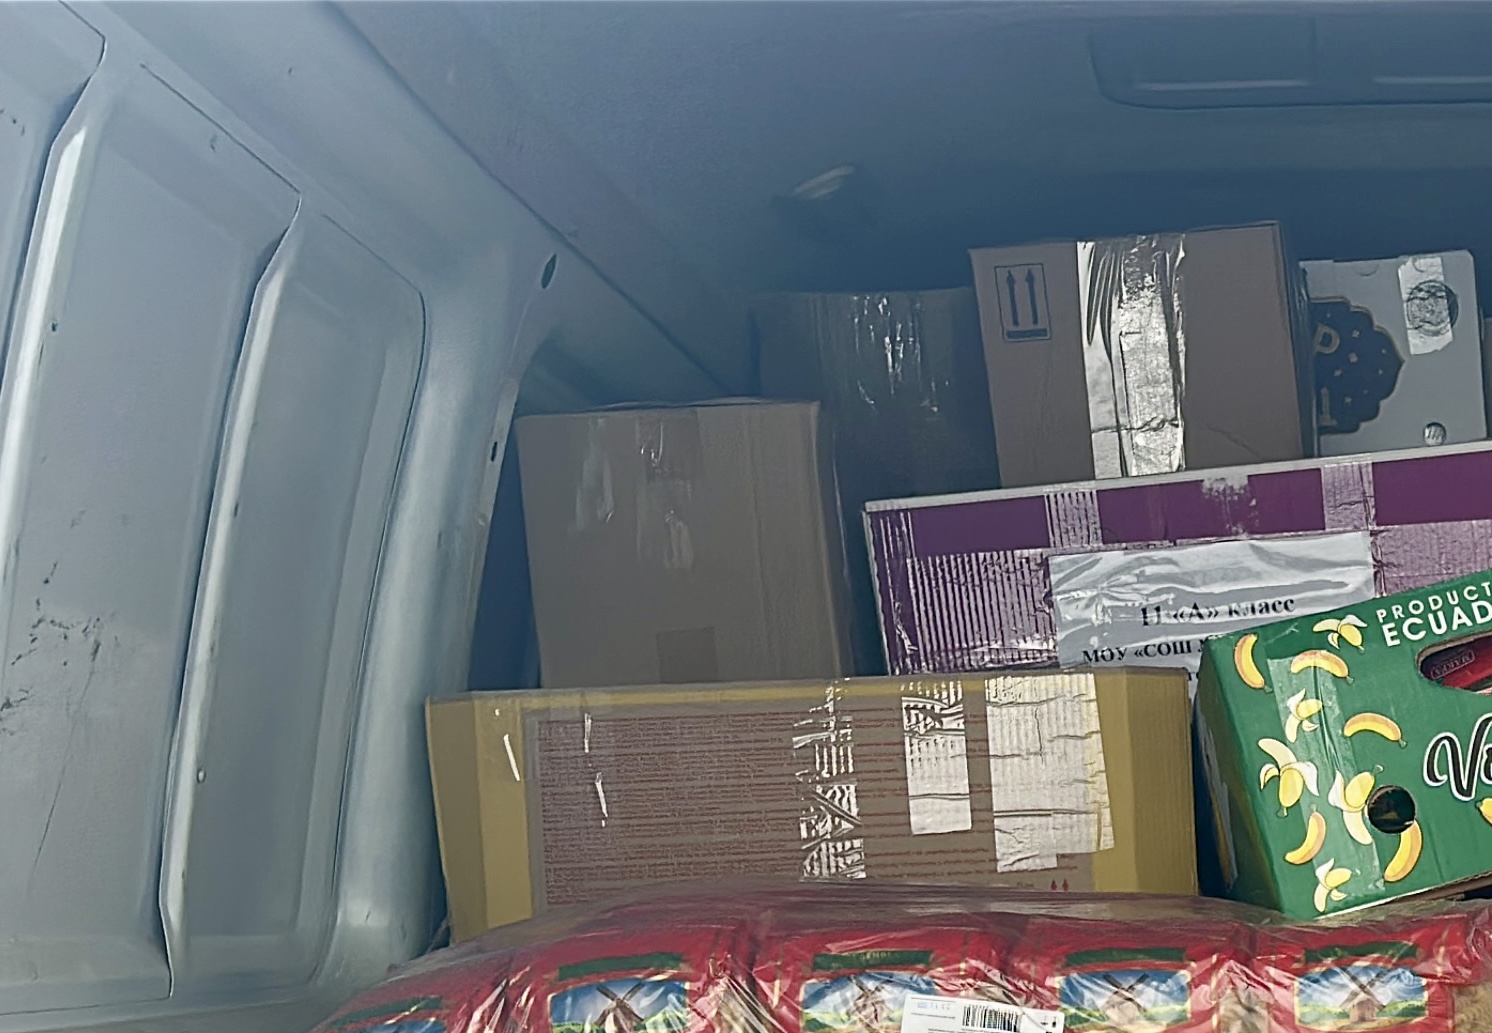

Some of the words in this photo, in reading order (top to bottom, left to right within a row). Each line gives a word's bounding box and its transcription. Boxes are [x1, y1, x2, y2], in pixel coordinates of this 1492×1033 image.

[1228, 598, 1295, 618] класс
[1376, 582, 1492, 624] PRODUCT
[1082, 646, 1128, 664] МОУ
